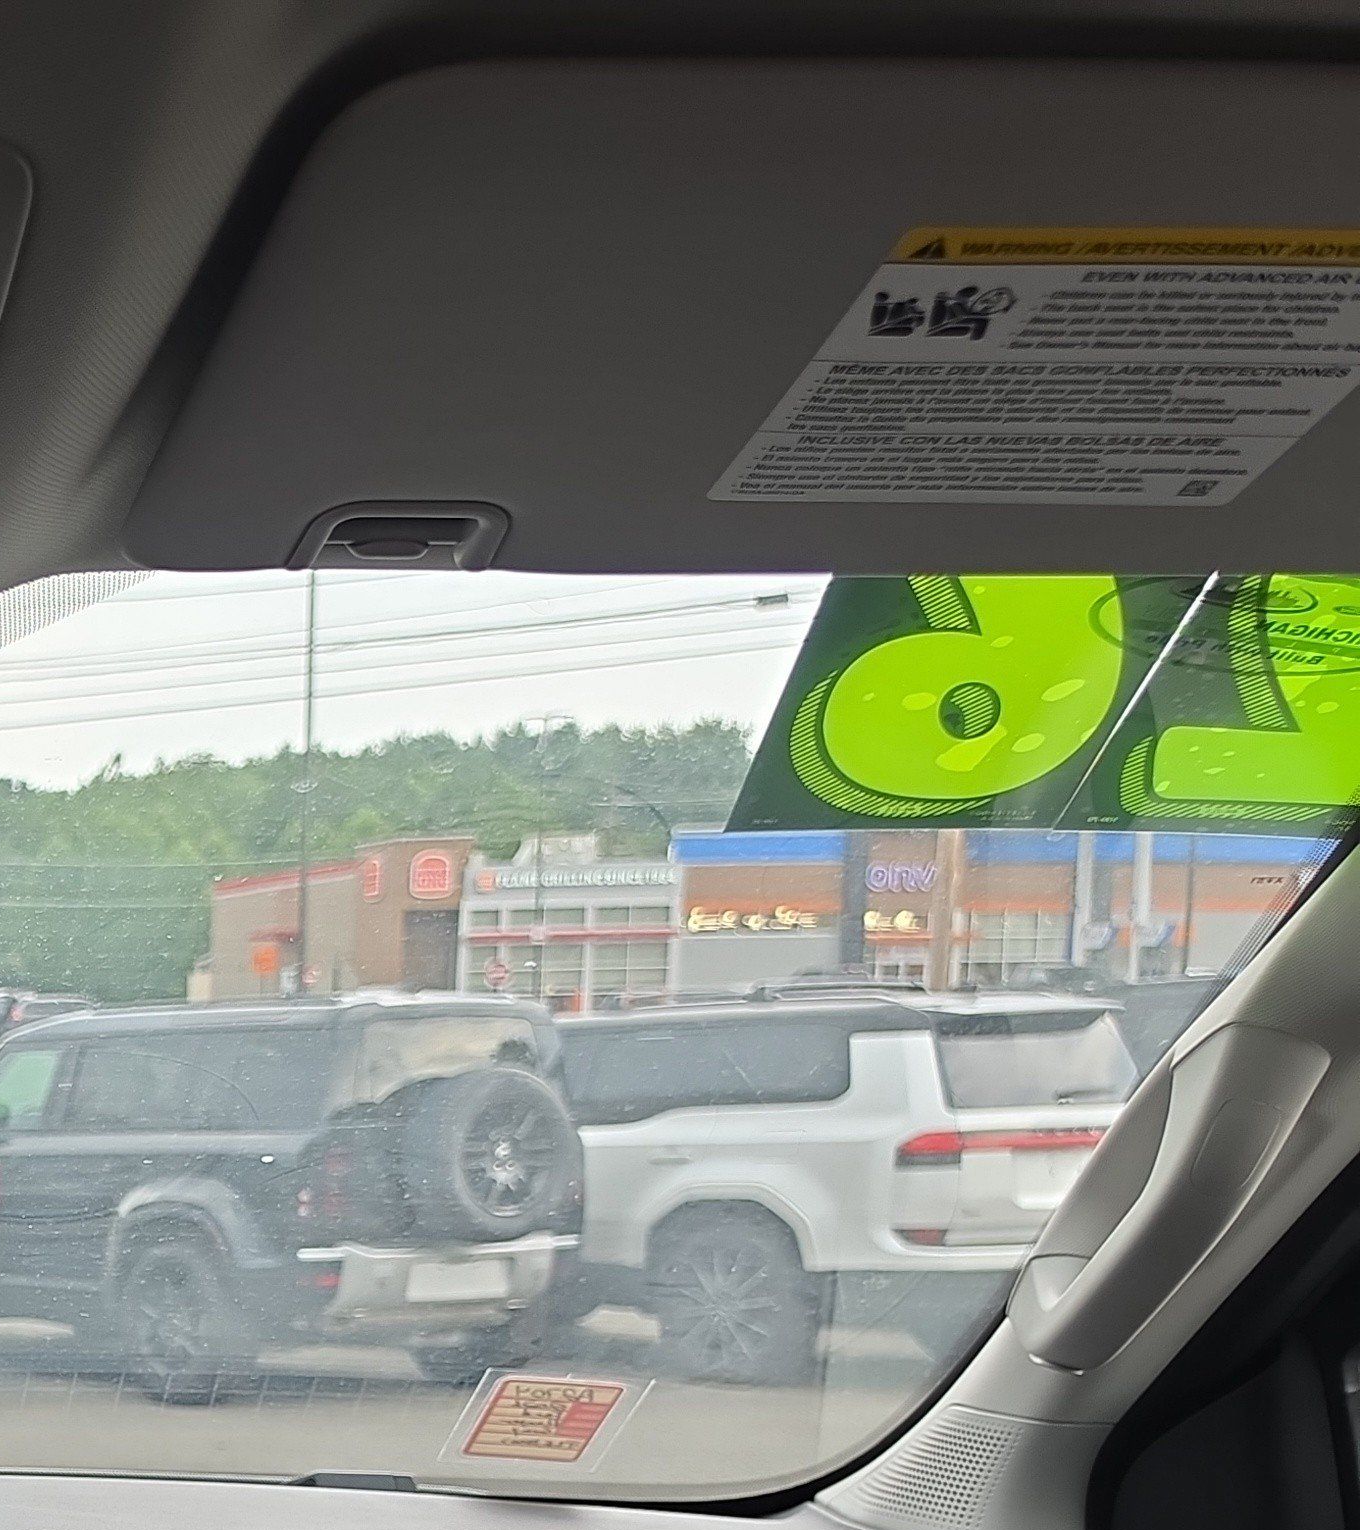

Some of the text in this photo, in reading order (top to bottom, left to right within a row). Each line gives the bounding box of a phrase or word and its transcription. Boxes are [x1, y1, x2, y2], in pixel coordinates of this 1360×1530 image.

[888, 364, 943, 376] AVEC
[945, 365, 986, 376] DES
[797, 435, 894, 446] INCLUSIVE
[898, 435, 942, 446] CON
[944, 435, 981, 446] LAS
[985, 435, 1061, 447] NUEVAS
[1147, 436, 1176, 447] DE
[1178, 436, 1227, 447] AIRE
